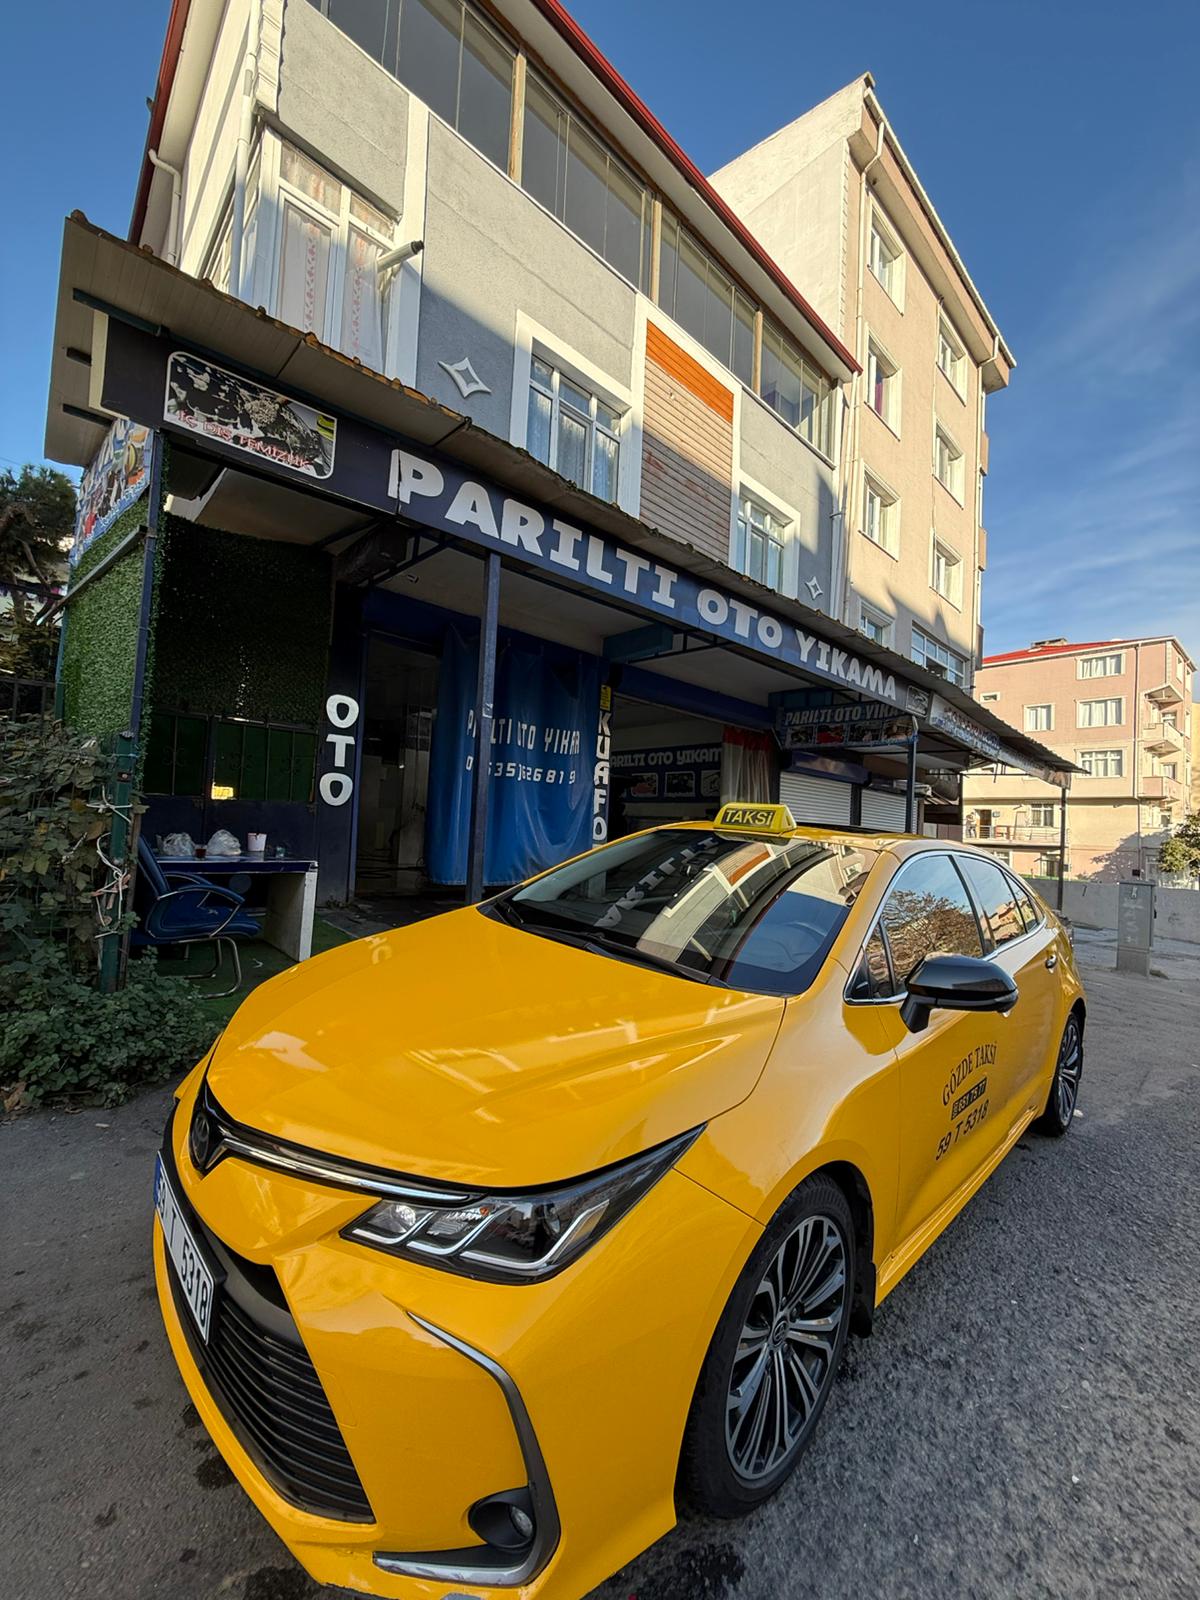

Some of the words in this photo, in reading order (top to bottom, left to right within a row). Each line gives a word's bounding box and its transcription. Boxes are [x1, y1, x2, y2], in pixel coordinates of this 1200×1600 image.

[387, 448, 678, 609] PARILTI
[697, 588, 783, 649] OTO
[795, 629, 897, 701] YIKAMA
[784, 708, 832, 727] PARILTI
[835, 705, 862, 722] OTO
[319, 694, 360, 806] OTO
[610, 753, 646, 768] ARILTI
[648, 751, 673, 766] OTO
[943, 1053, 973, 1106] GÖZDE
[954, 1121, 964, 1143] T
[170, 1206, 177, 1248] T
[181, 1236, 208, 1327] 5318
